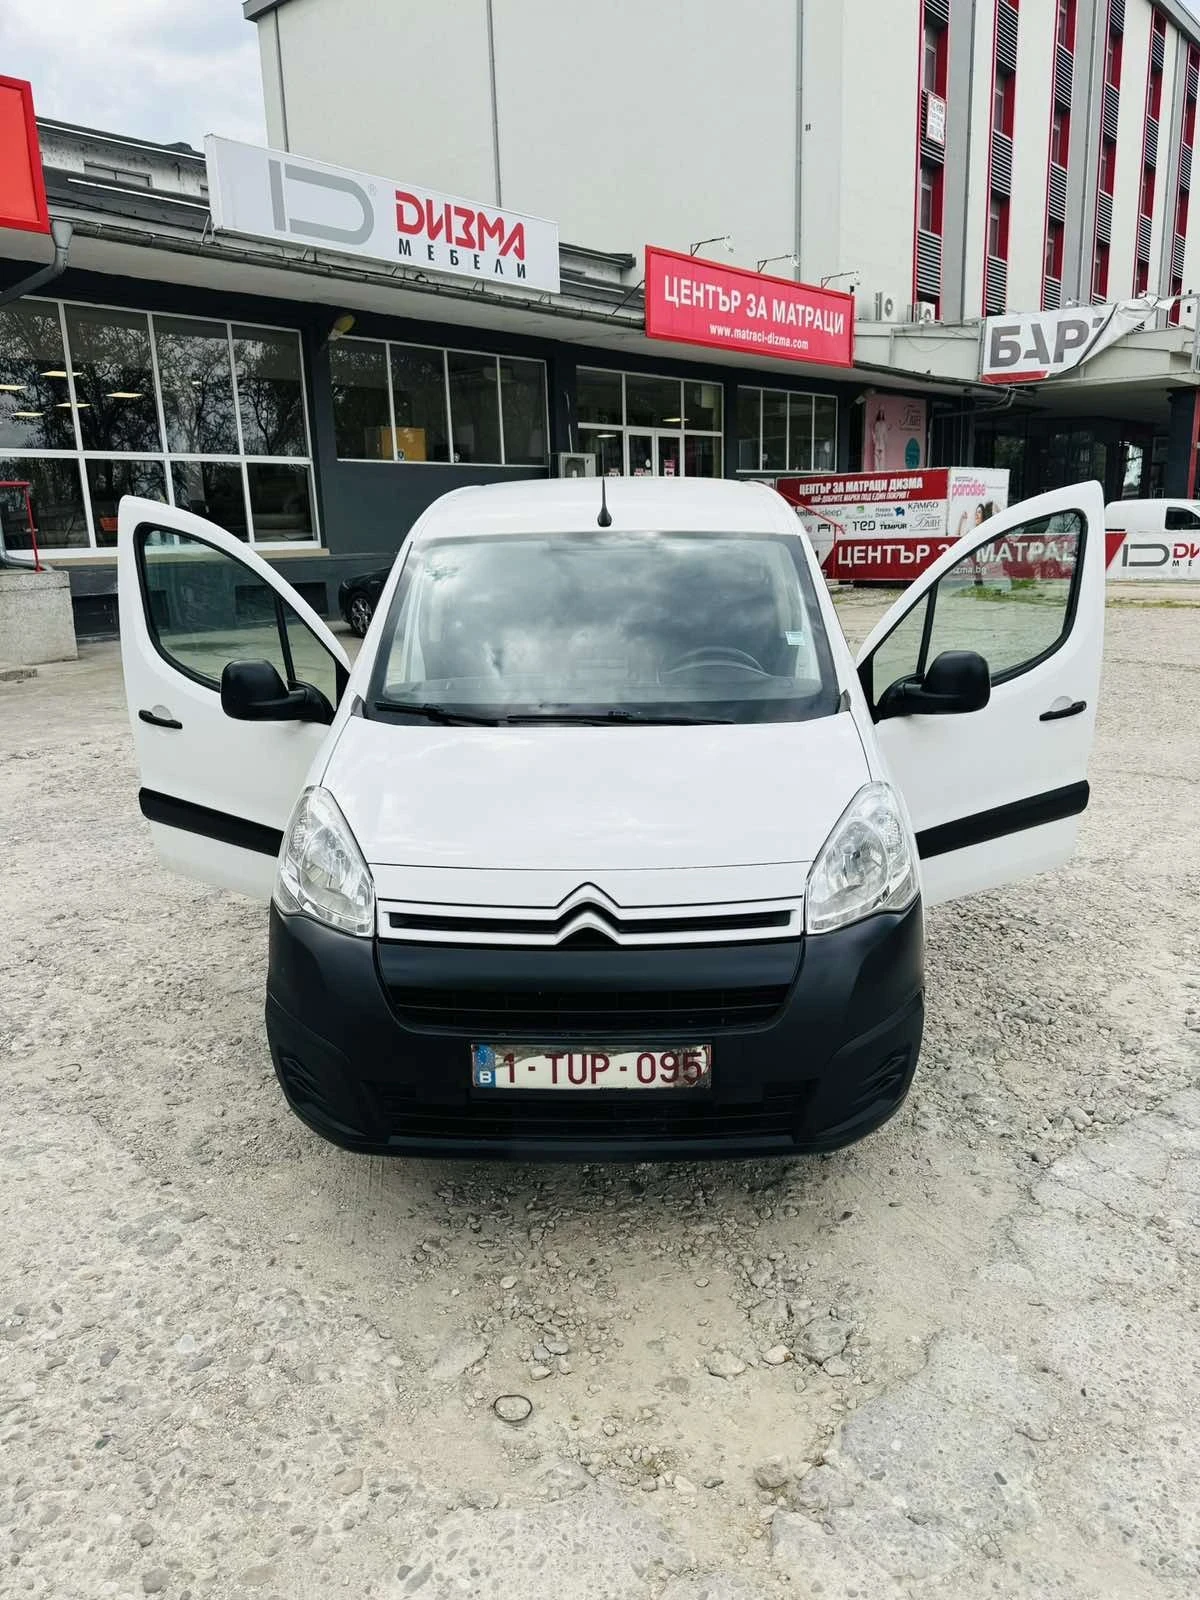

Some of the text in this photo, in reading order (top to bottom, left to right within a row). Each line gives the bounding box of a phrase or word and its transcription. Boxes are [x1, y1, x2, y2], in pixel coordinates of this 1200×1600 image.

[395, 190, 525, 261] ДИЗМА
[398, 238, 526, 279] МЕБЕЛИ
[664, 275, 844, 336] ЦЕНТЪР ЗА МАТРАЦИ
[709, 323, 809, 350] www.matraci-dizma.com
[799, 477, 923, 496] ЦЕНТЪР ЗА МАТРАЦИ ДИЗМА
[838, 544, 930, 568] ЦЕНТЪР
[976, 541, 1077, 563] МАТРАЦ
[479, 1070, 492, 1084] B
